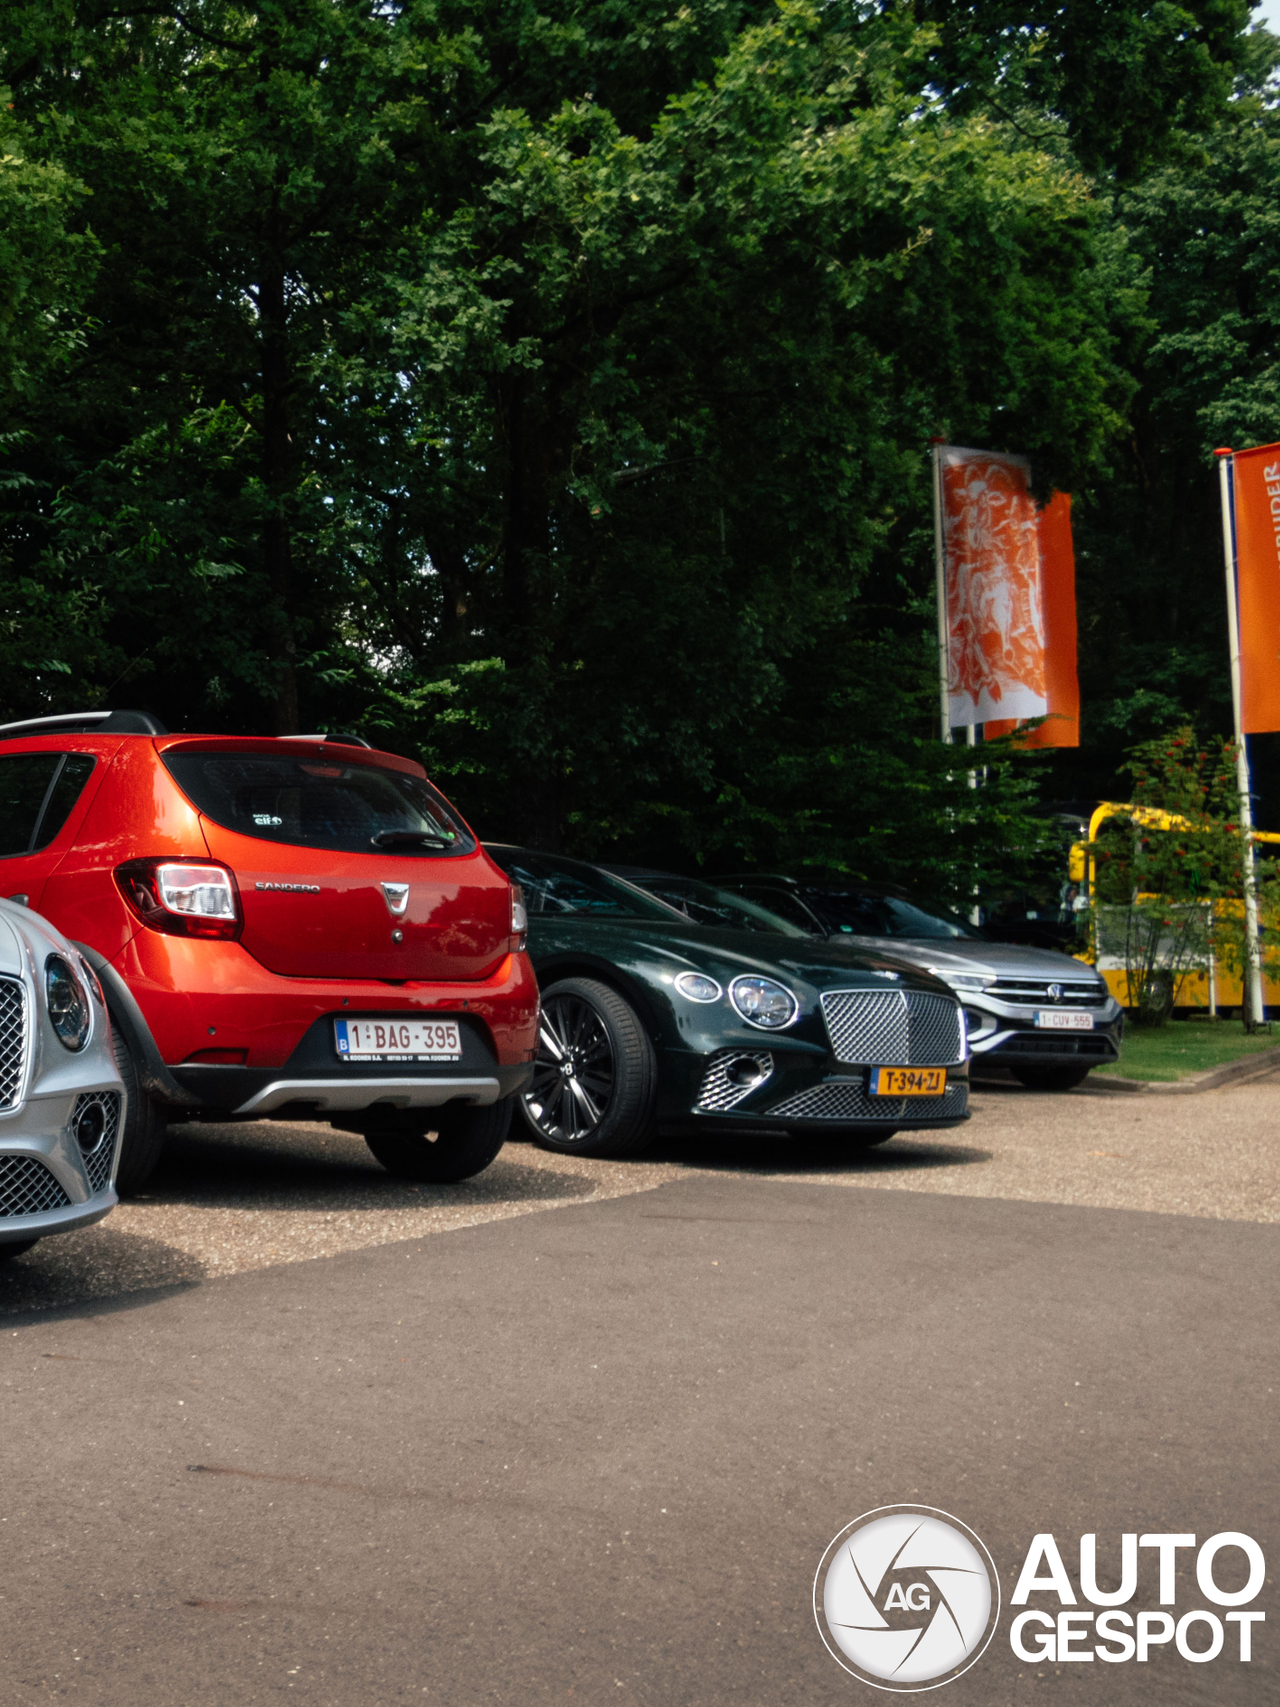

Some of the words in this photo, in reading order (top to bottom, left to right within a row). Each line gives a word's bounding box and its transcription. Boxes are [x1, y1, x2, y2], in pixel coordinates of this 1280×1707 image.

[255, 882, 320, 894] SANDERO
[340, 1039, 348, 1051] B
[886, 1071, 941, 1091] T-394-ZJ
